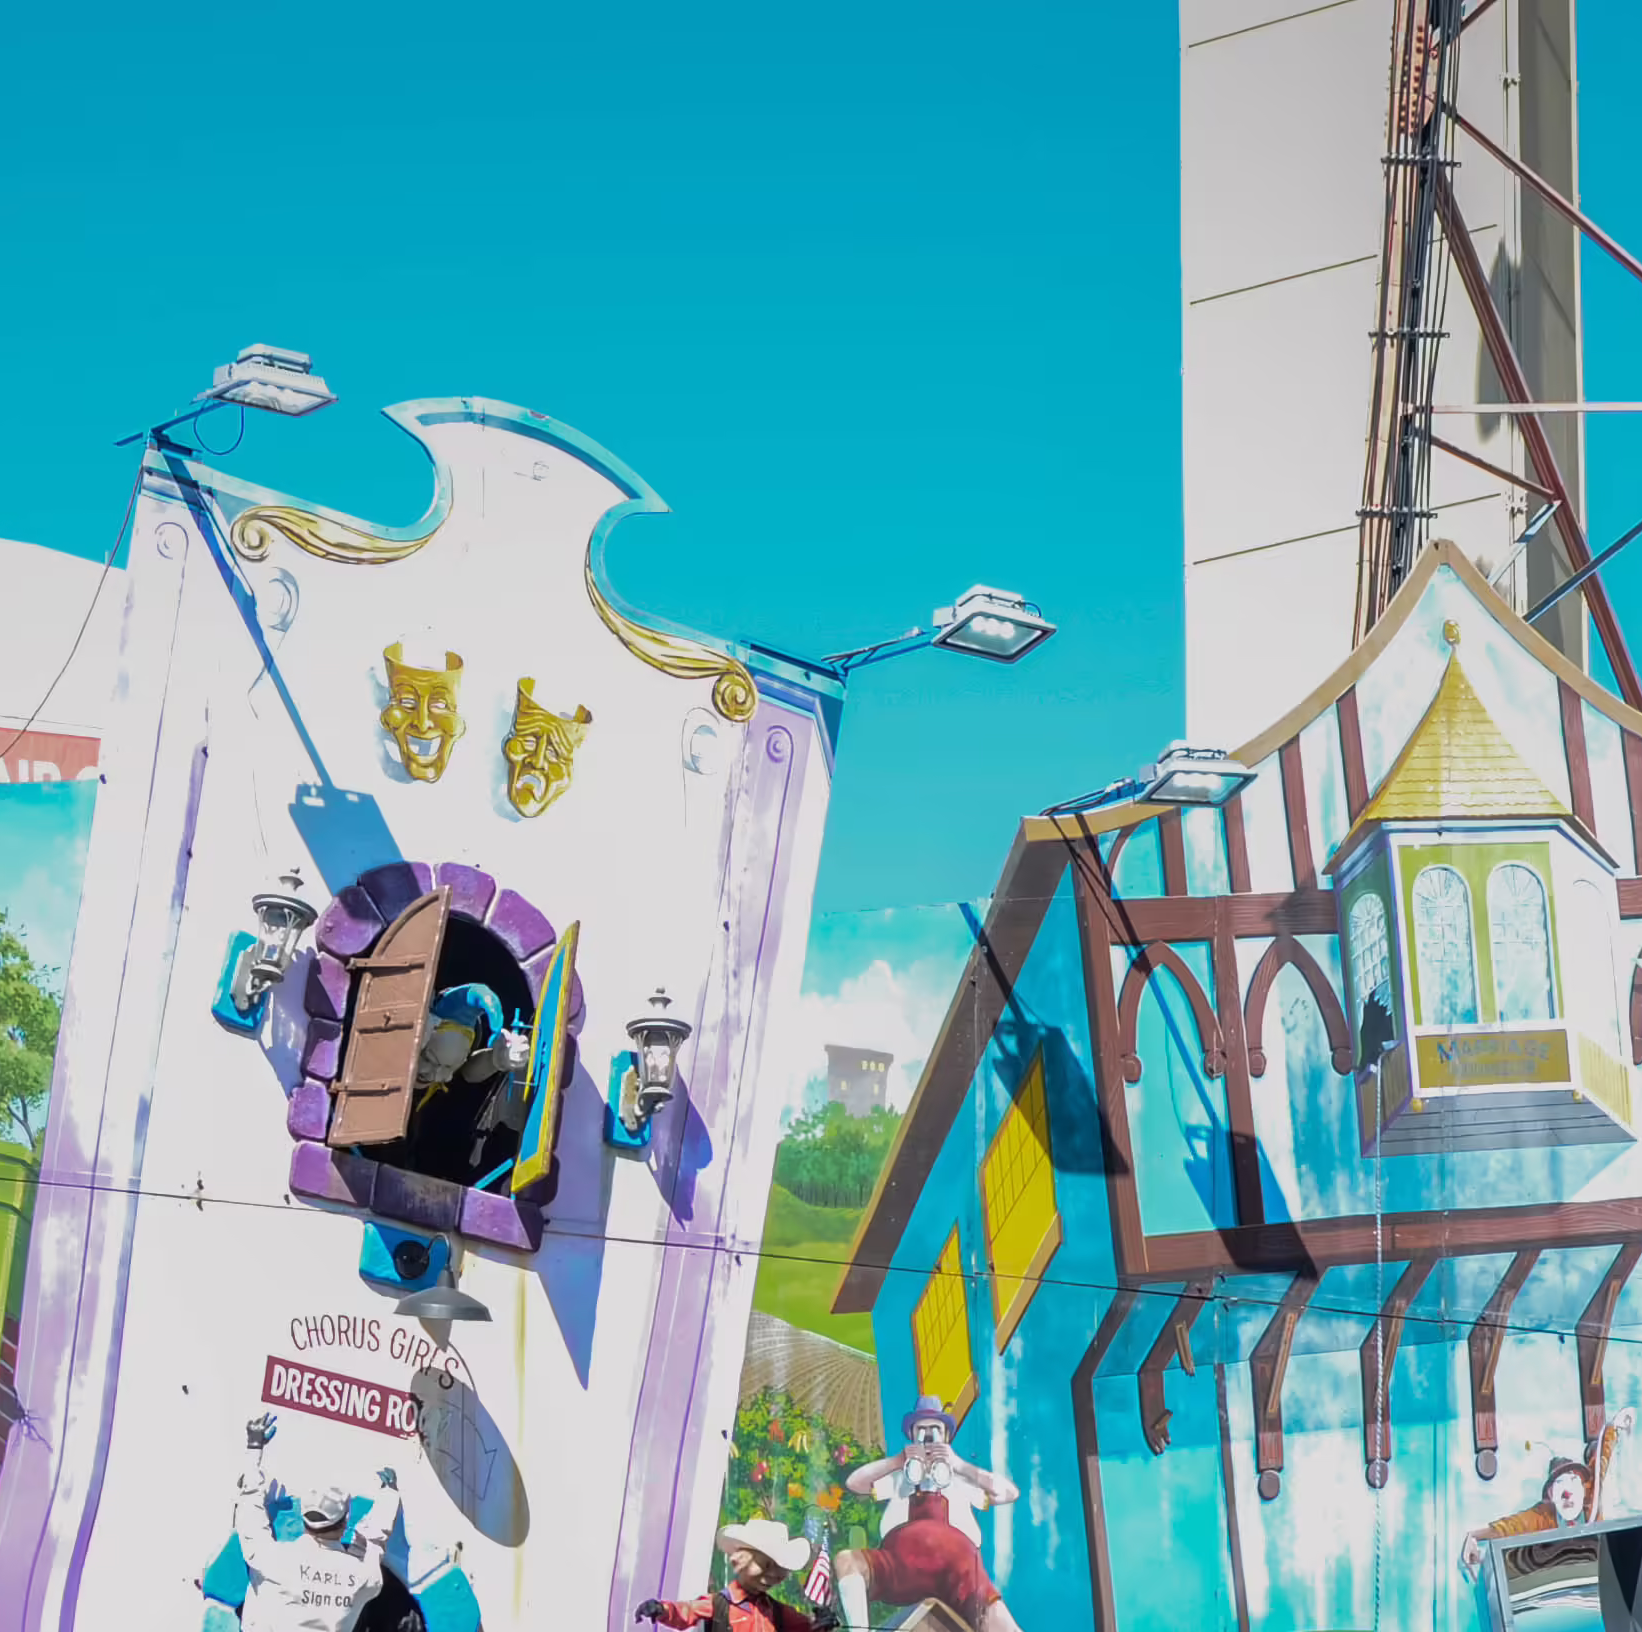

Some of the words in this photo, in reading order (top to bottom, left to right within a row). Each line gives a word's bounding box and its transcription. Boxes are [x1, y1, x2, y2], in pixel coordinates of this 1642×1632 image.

[290, 1314, 381, 1352] CHORUS
[389, 1327, 460, 1390] GIRLS
[270, 1364, 382, 1423] DRESSING
[385, 1393, 430, 1433] RO
